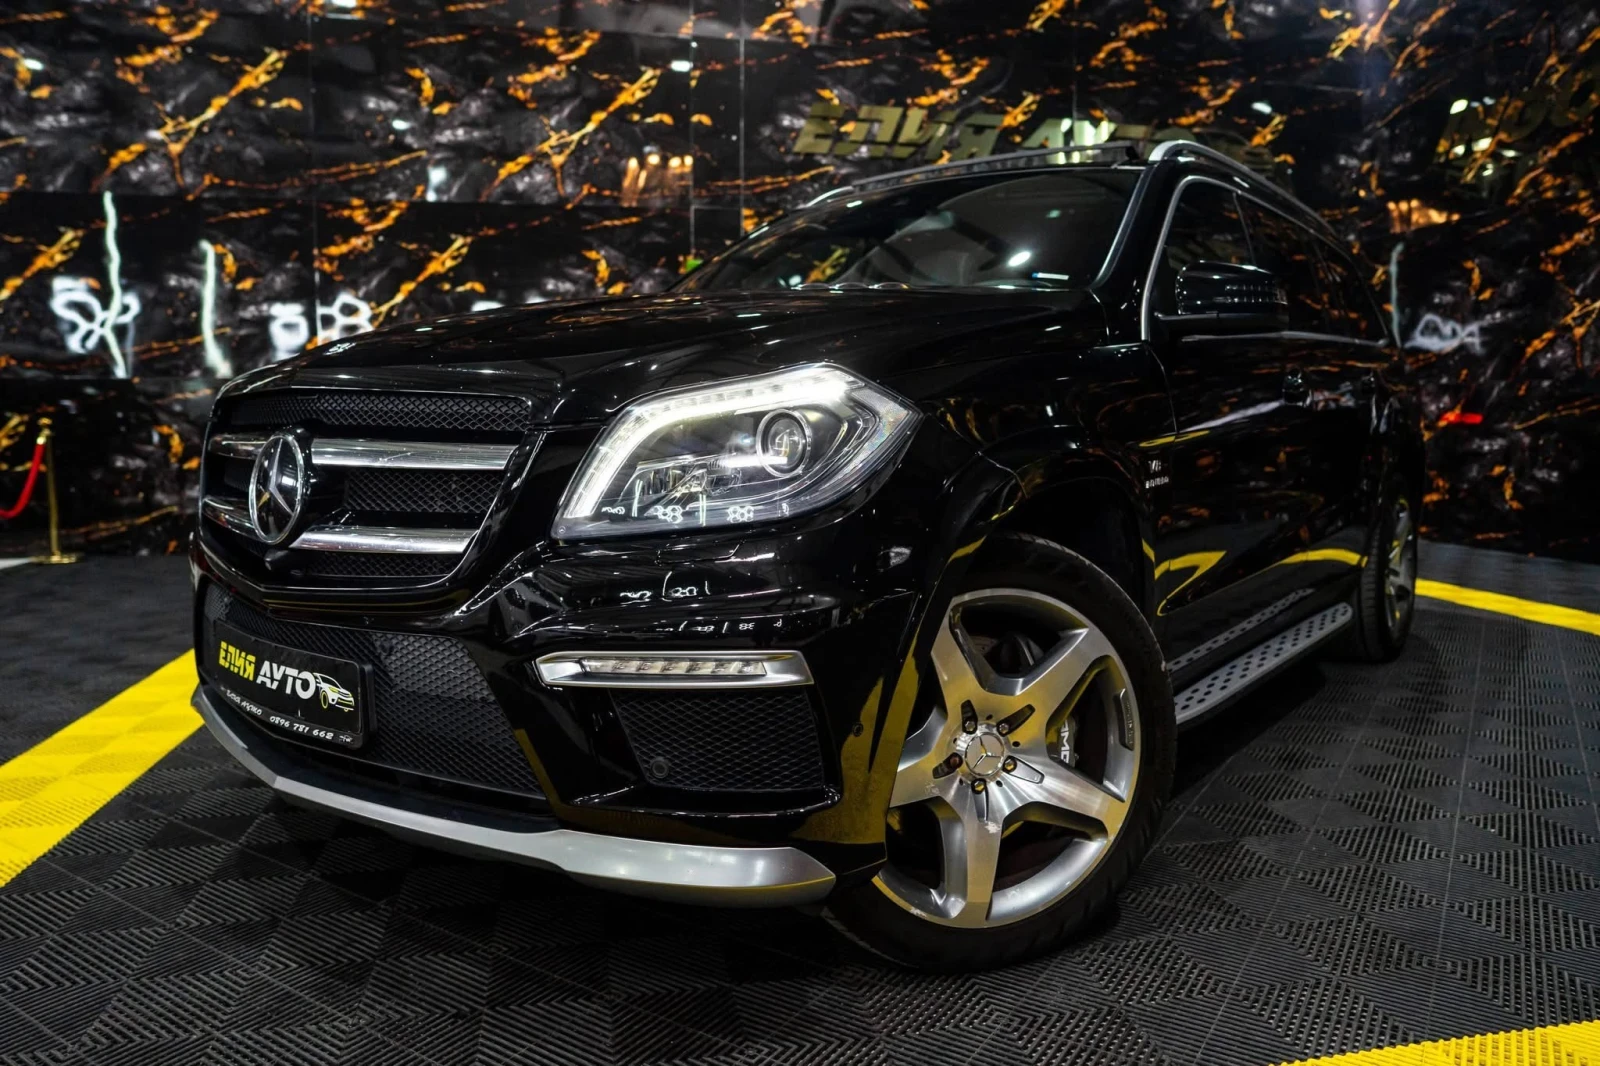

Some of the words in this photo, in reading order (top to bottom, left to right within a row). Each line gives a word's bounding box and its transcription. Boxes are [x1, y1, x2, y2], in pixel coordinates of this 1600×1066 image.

[792, 102, 1007, 161] ЕЛИЯ
[218, 640, 256, 681] ЕЛИЯ
[255, 660, 316, 700] АУТО
[293, 723, 310, 734] 781
